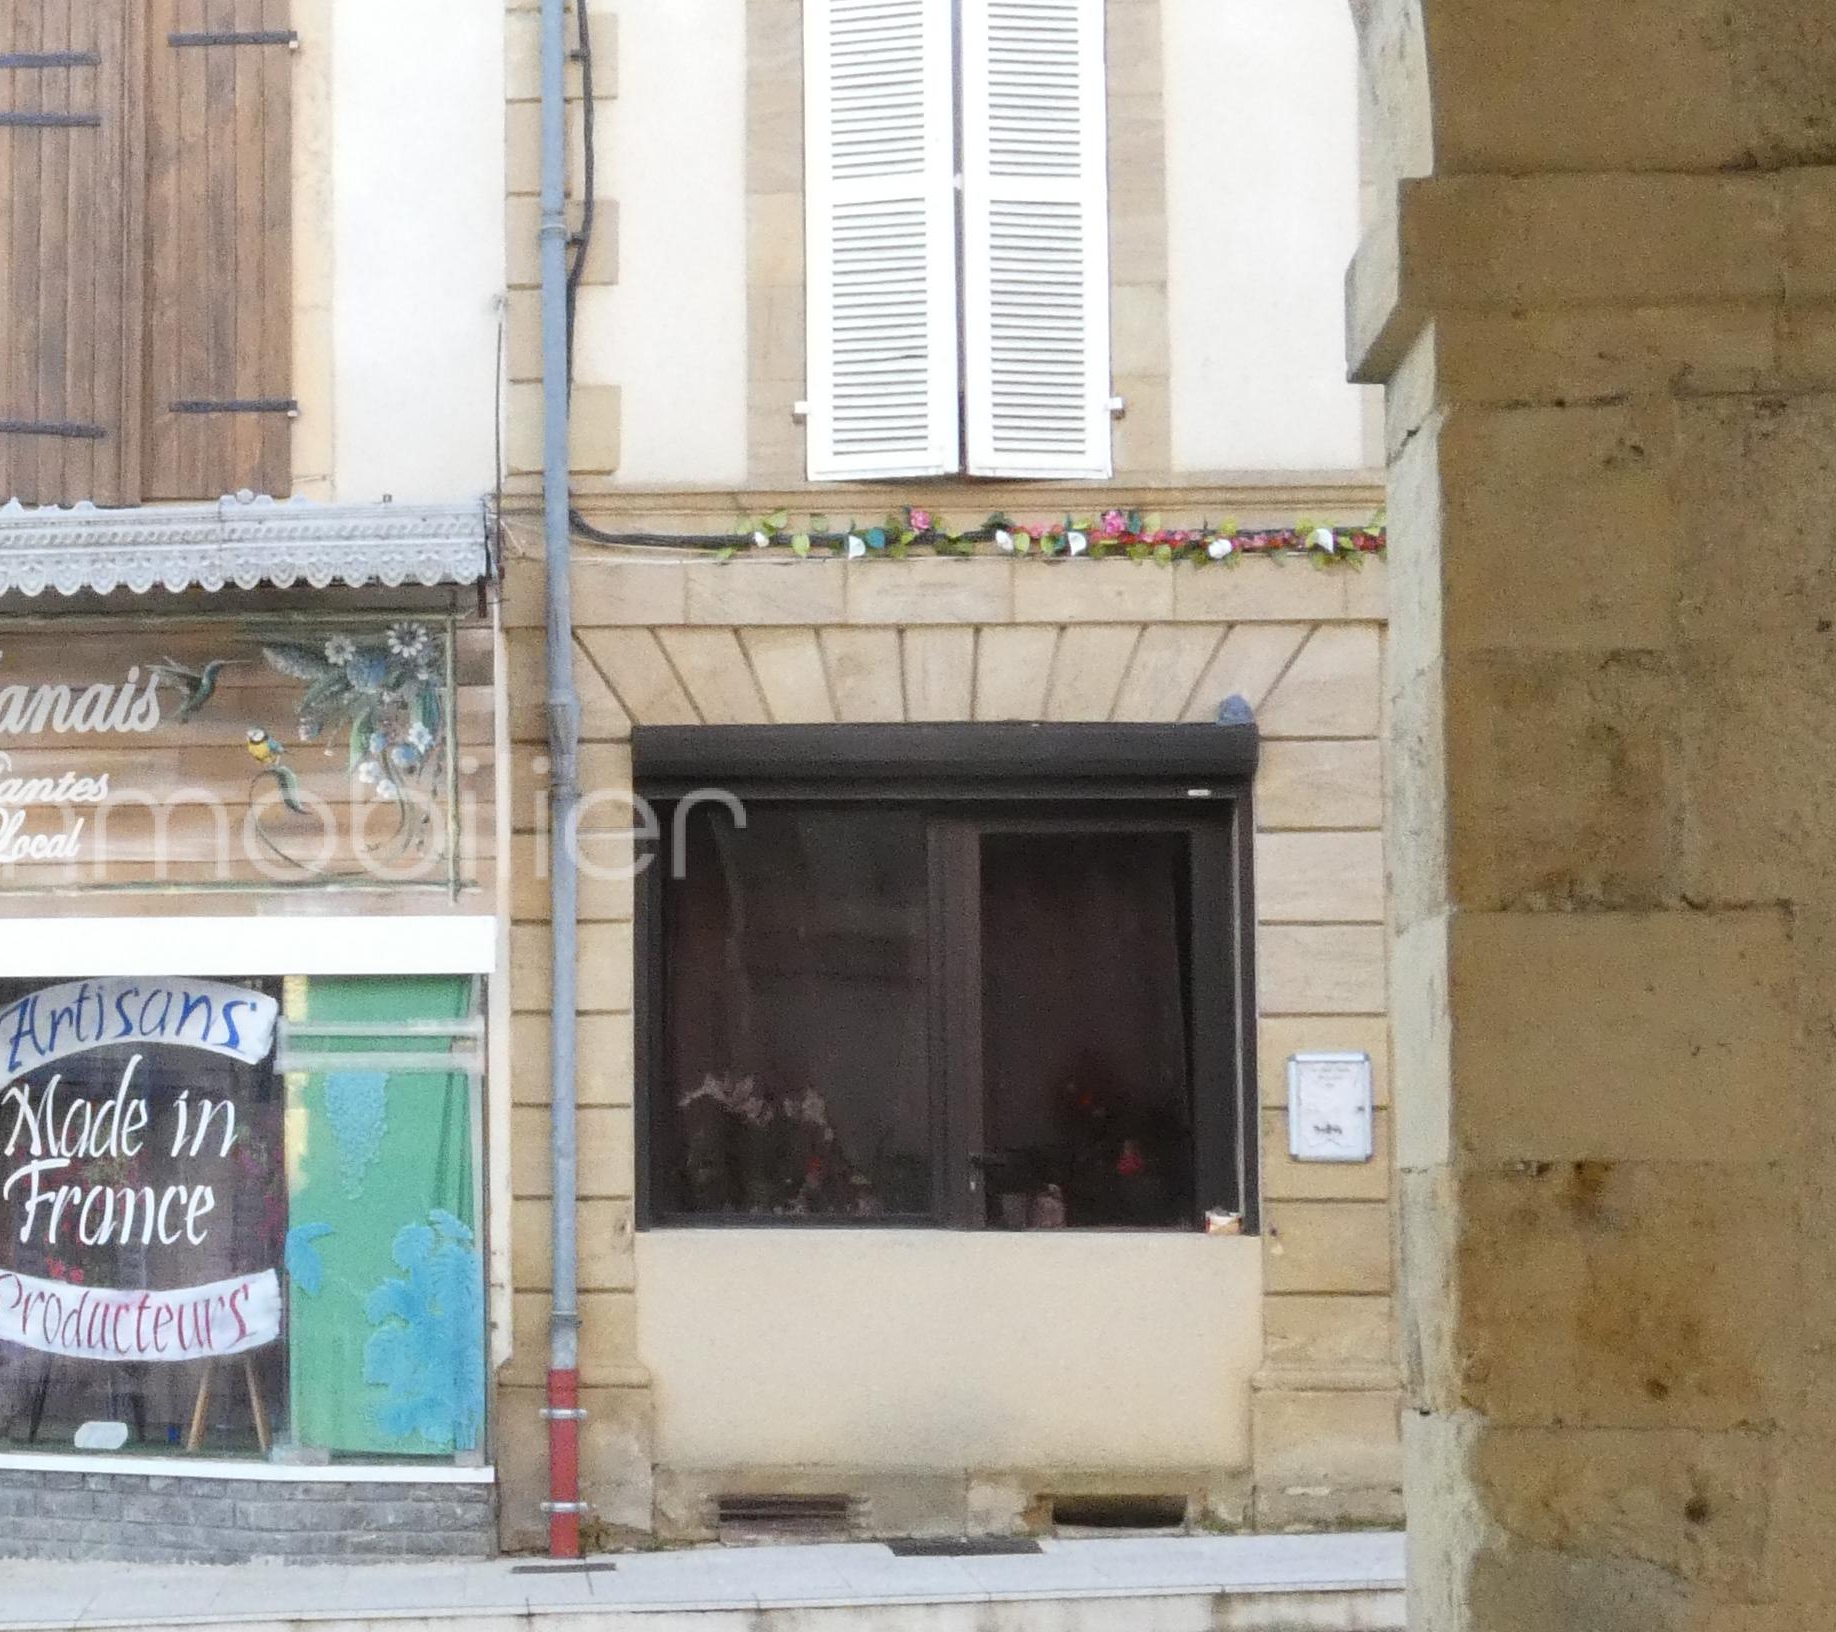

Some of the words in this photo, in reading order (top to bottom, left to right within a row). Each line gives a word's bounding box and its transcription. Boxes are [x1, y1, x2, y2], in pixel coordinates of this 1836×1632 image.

[1, 1054, 148, 1158] Made
[169, 1089, 237, 1158] in
[2, 1158, 216, 1246] France
